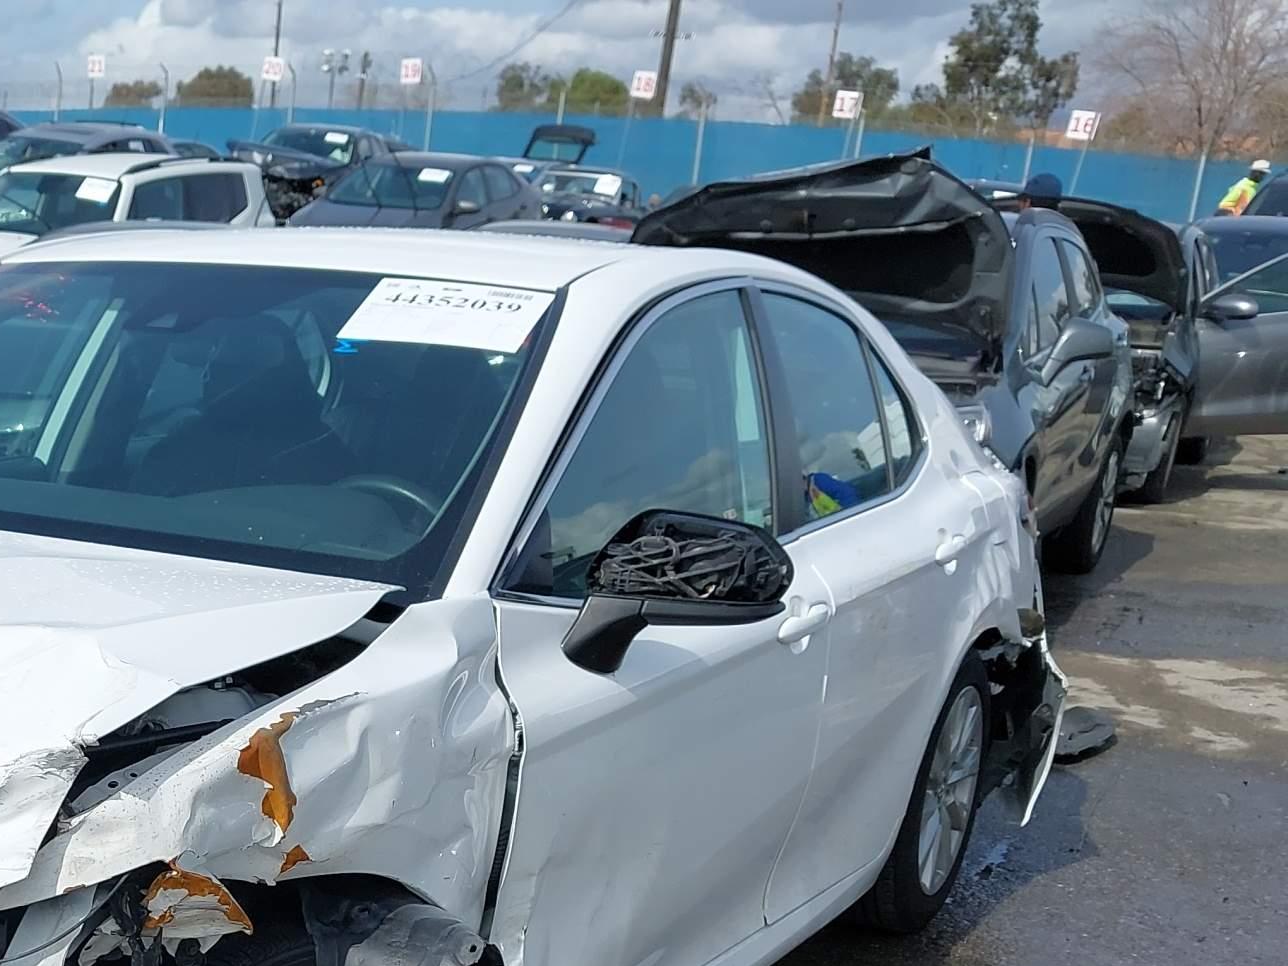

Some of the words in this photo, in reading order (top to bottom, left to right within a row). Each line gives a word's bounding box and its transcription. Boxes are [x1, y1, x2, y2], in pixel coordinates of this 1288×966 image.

[263, 61, 283, 75] 20
[404, 63, 421, 79] 19
[635, 76, 655, 93] 18
[836, 96, 859, 113] 17
[1071, 117, 1094, 134] 16
[384, 291, 523, 314] 44352039
